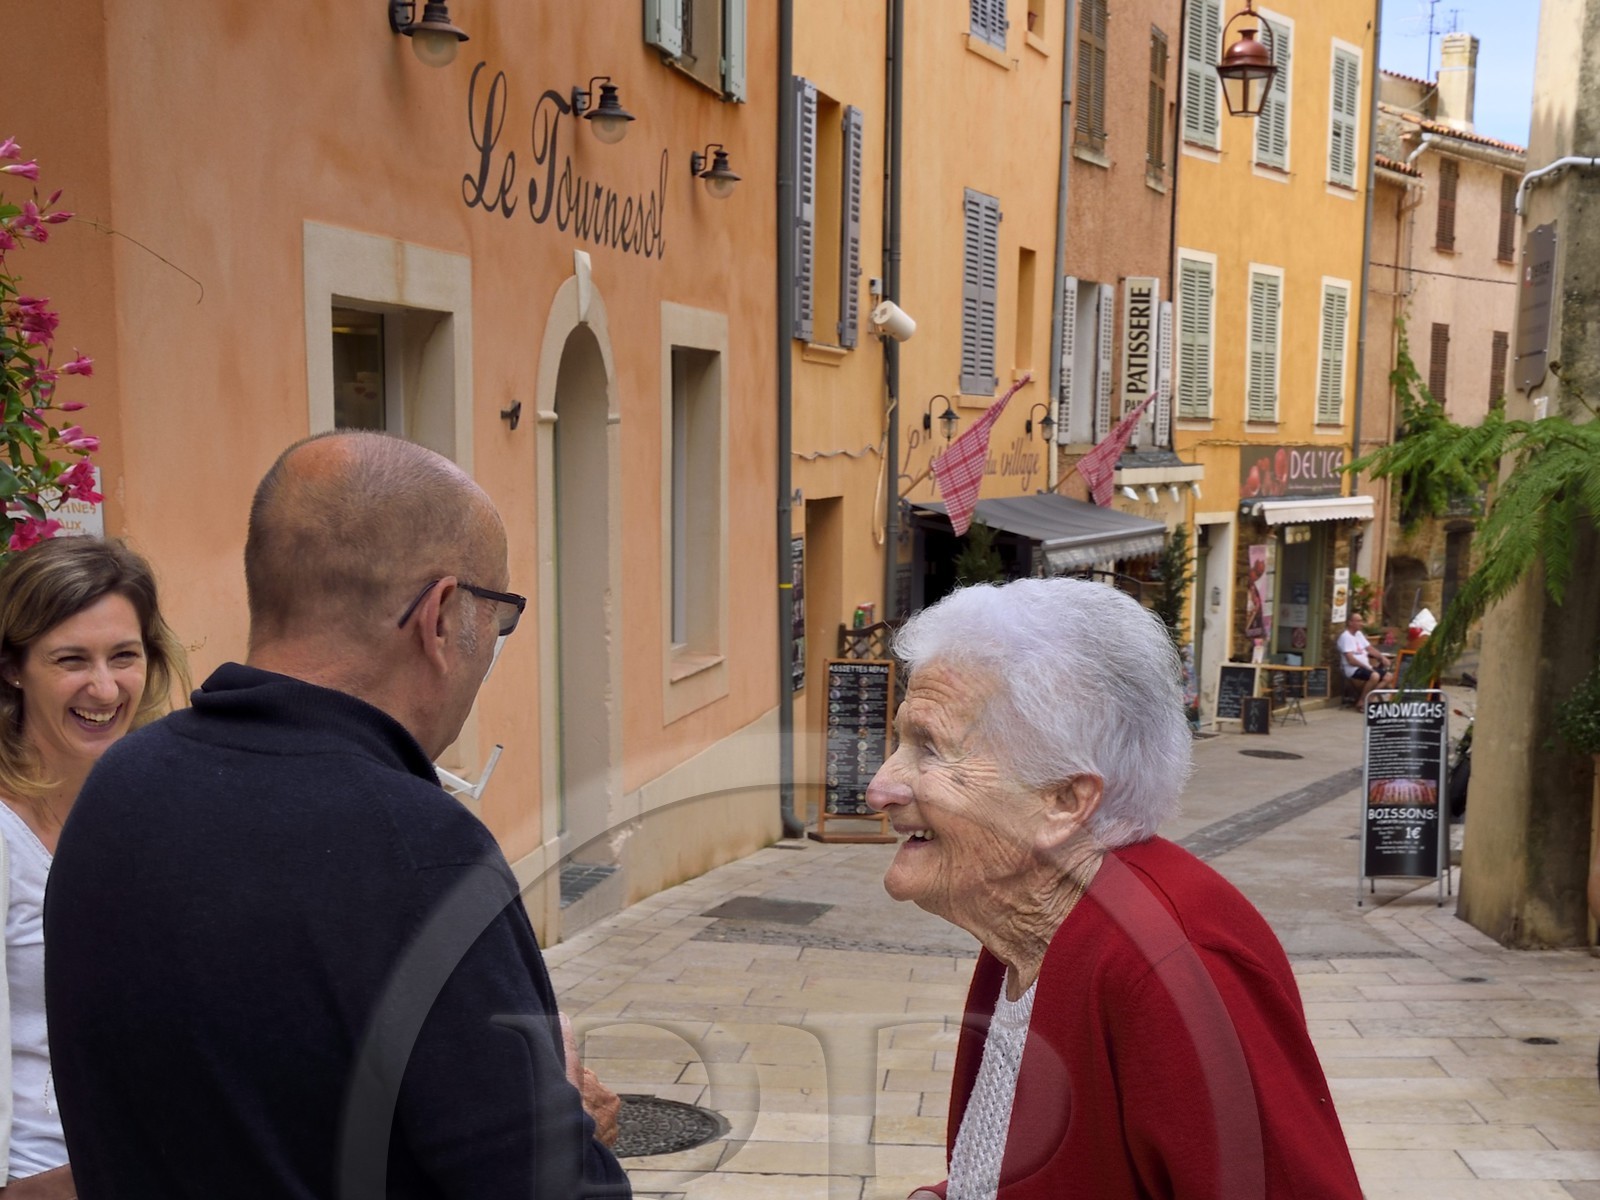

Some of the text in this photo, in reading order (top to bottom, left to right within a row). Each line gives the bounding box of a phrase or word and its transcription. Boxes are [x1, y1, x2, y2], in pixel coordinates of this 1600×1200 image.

[461, 61, 669, 260] Le Tournesol
[1126, 287, 1151, 394] PATISSERIE
[1000, 436, 1041, 492] village
[1367, 807, 1439, 820] BOISSONS:
[1405, 826, 1422, 839] 1€
